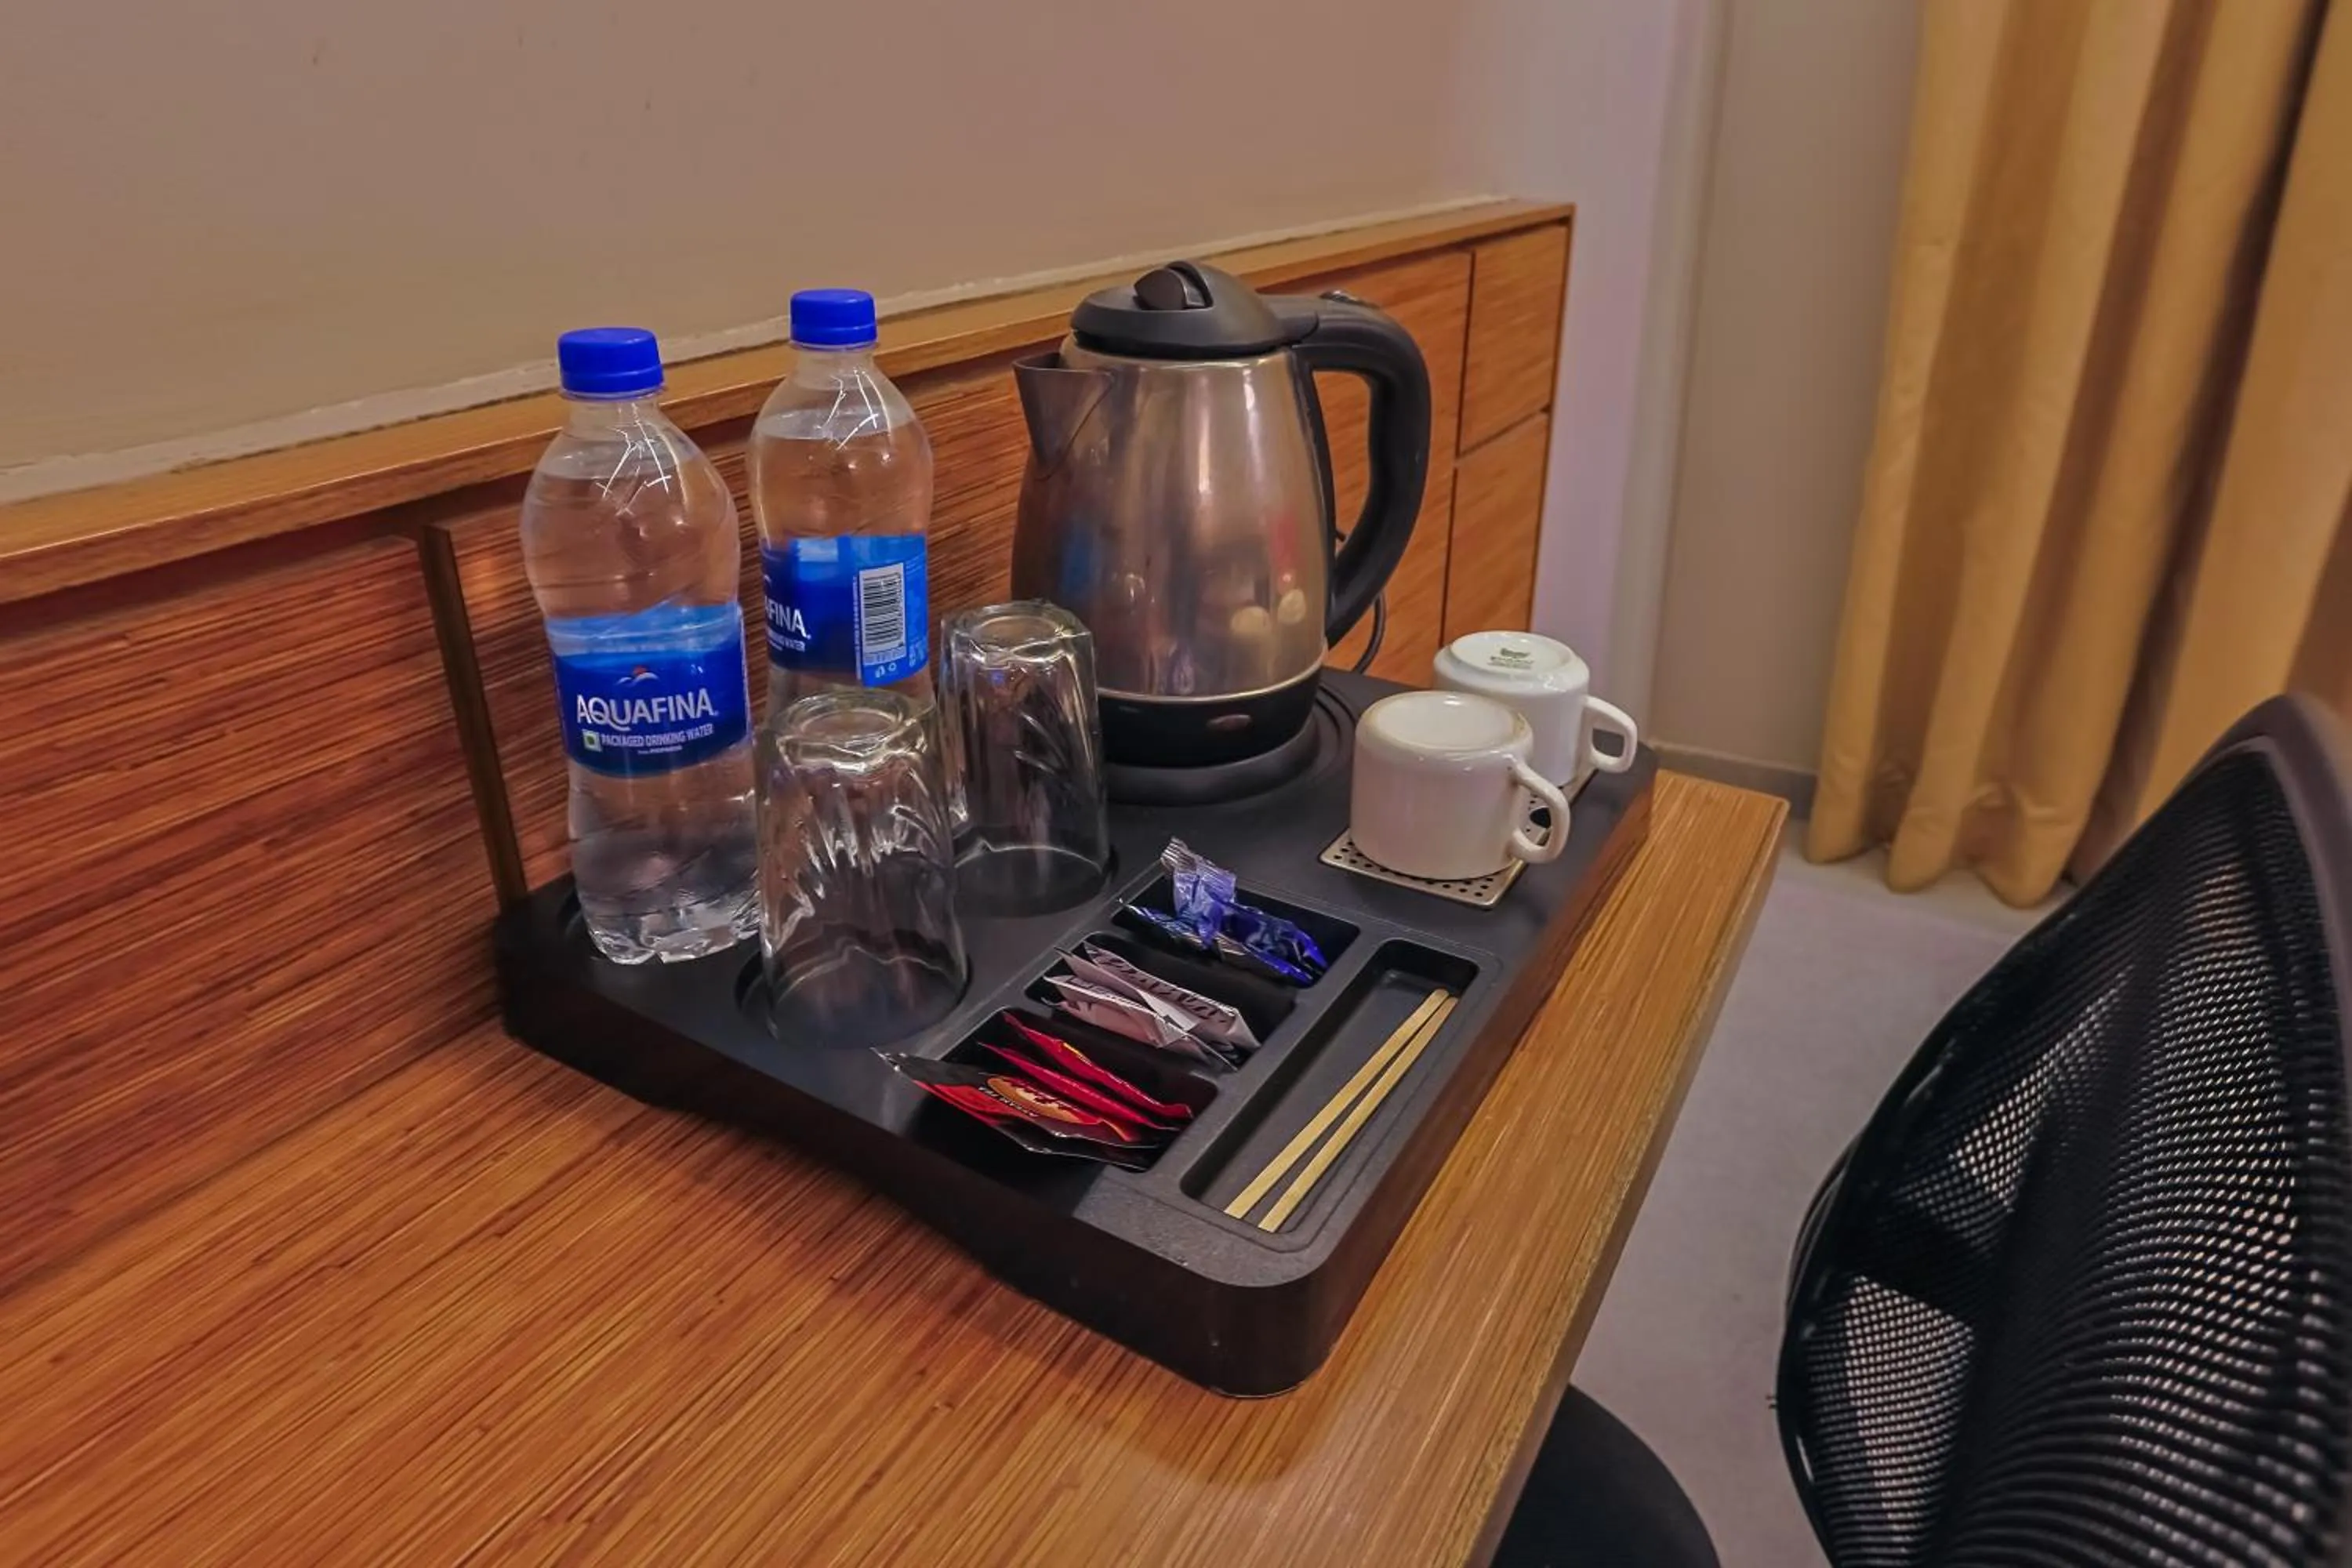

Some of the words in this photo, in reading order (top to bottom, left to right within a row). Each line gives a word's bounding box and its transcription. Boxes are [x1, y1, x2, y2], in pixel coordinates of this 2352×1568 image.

[577, 687, 715, 731] AQUAFINA
[601, 733, 644, 747] PACKAGED
[645, 730, 686, 746] DRINKING
[686, 723, 714, 742] WATER
